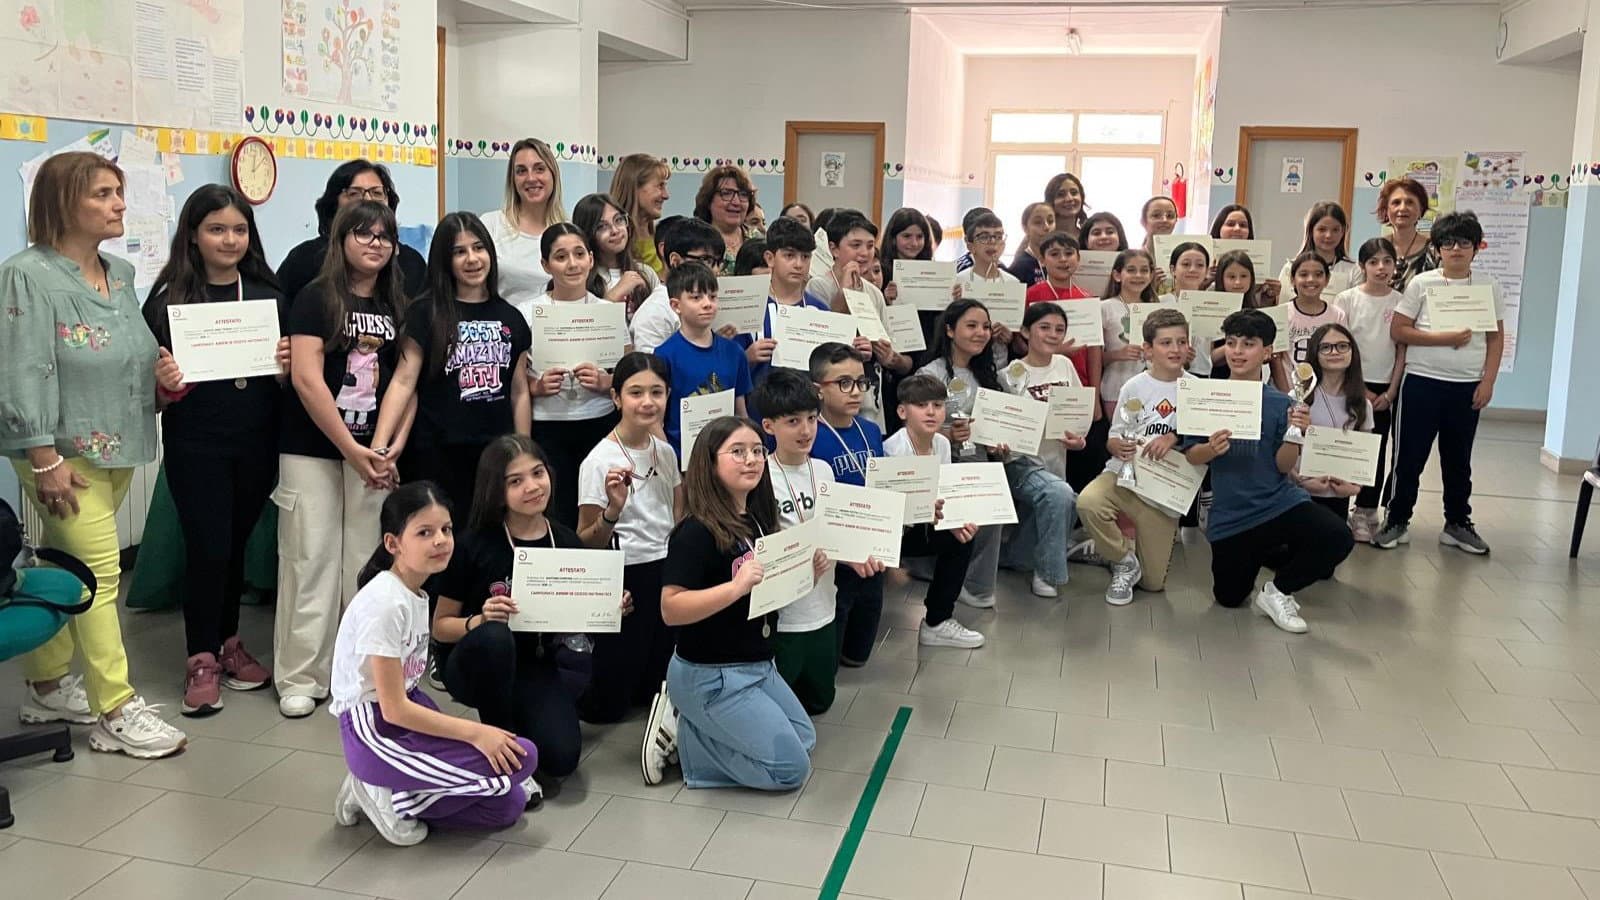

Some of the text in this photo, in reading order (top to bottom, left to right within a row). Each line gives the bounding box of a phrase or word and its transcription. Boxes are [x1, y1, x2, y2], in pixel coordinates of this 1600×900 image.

[345, 311, 395, 340] GUESS
[458, 321, 502, 342] BEST
[447, 342, 511, 367] AMAZING
[460, 366, 501, 389] CITY
